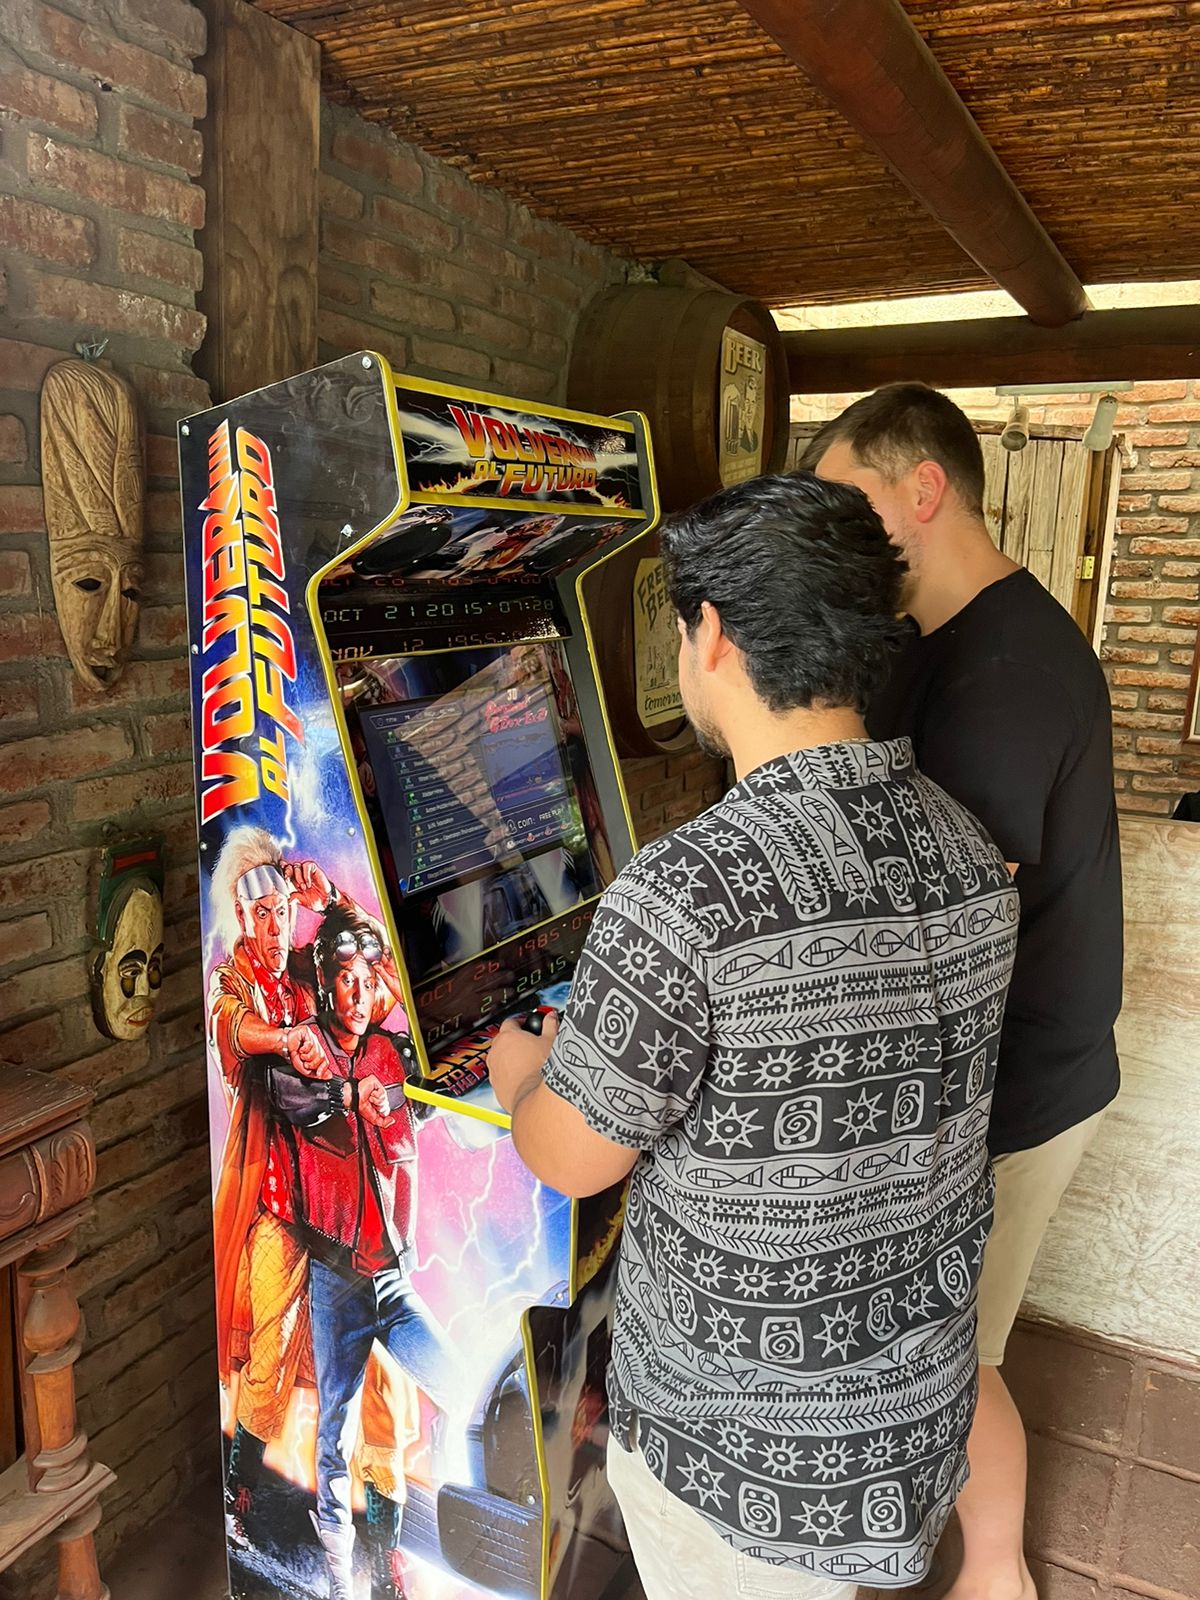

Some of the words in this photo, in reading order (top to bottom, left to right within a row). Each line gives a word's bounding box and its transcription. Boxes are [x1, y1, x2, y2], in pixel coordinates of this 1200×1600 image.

[723, 337, 763, 375] BEER
[447, 403, 597, 466] VOLVER
[474, 459, 502, 481] AL
[500, 463, 597, 497] FUTURO
[235, 425, 305, 747] FUTURO
[646, 586, 671, 631] BEE
[198, 419, 261, 827] VOLVER
[323, 608, 363, 623] OCT
[644, 691, 682, 711] tomorro
[258, 726, 291, 802] AL
[420, 980, 455, 1007] OCT
[473, 961, 501, 981] 26
[518, 928, 560, 957] 1985
[427, 1012, 463, 1044] OCT
